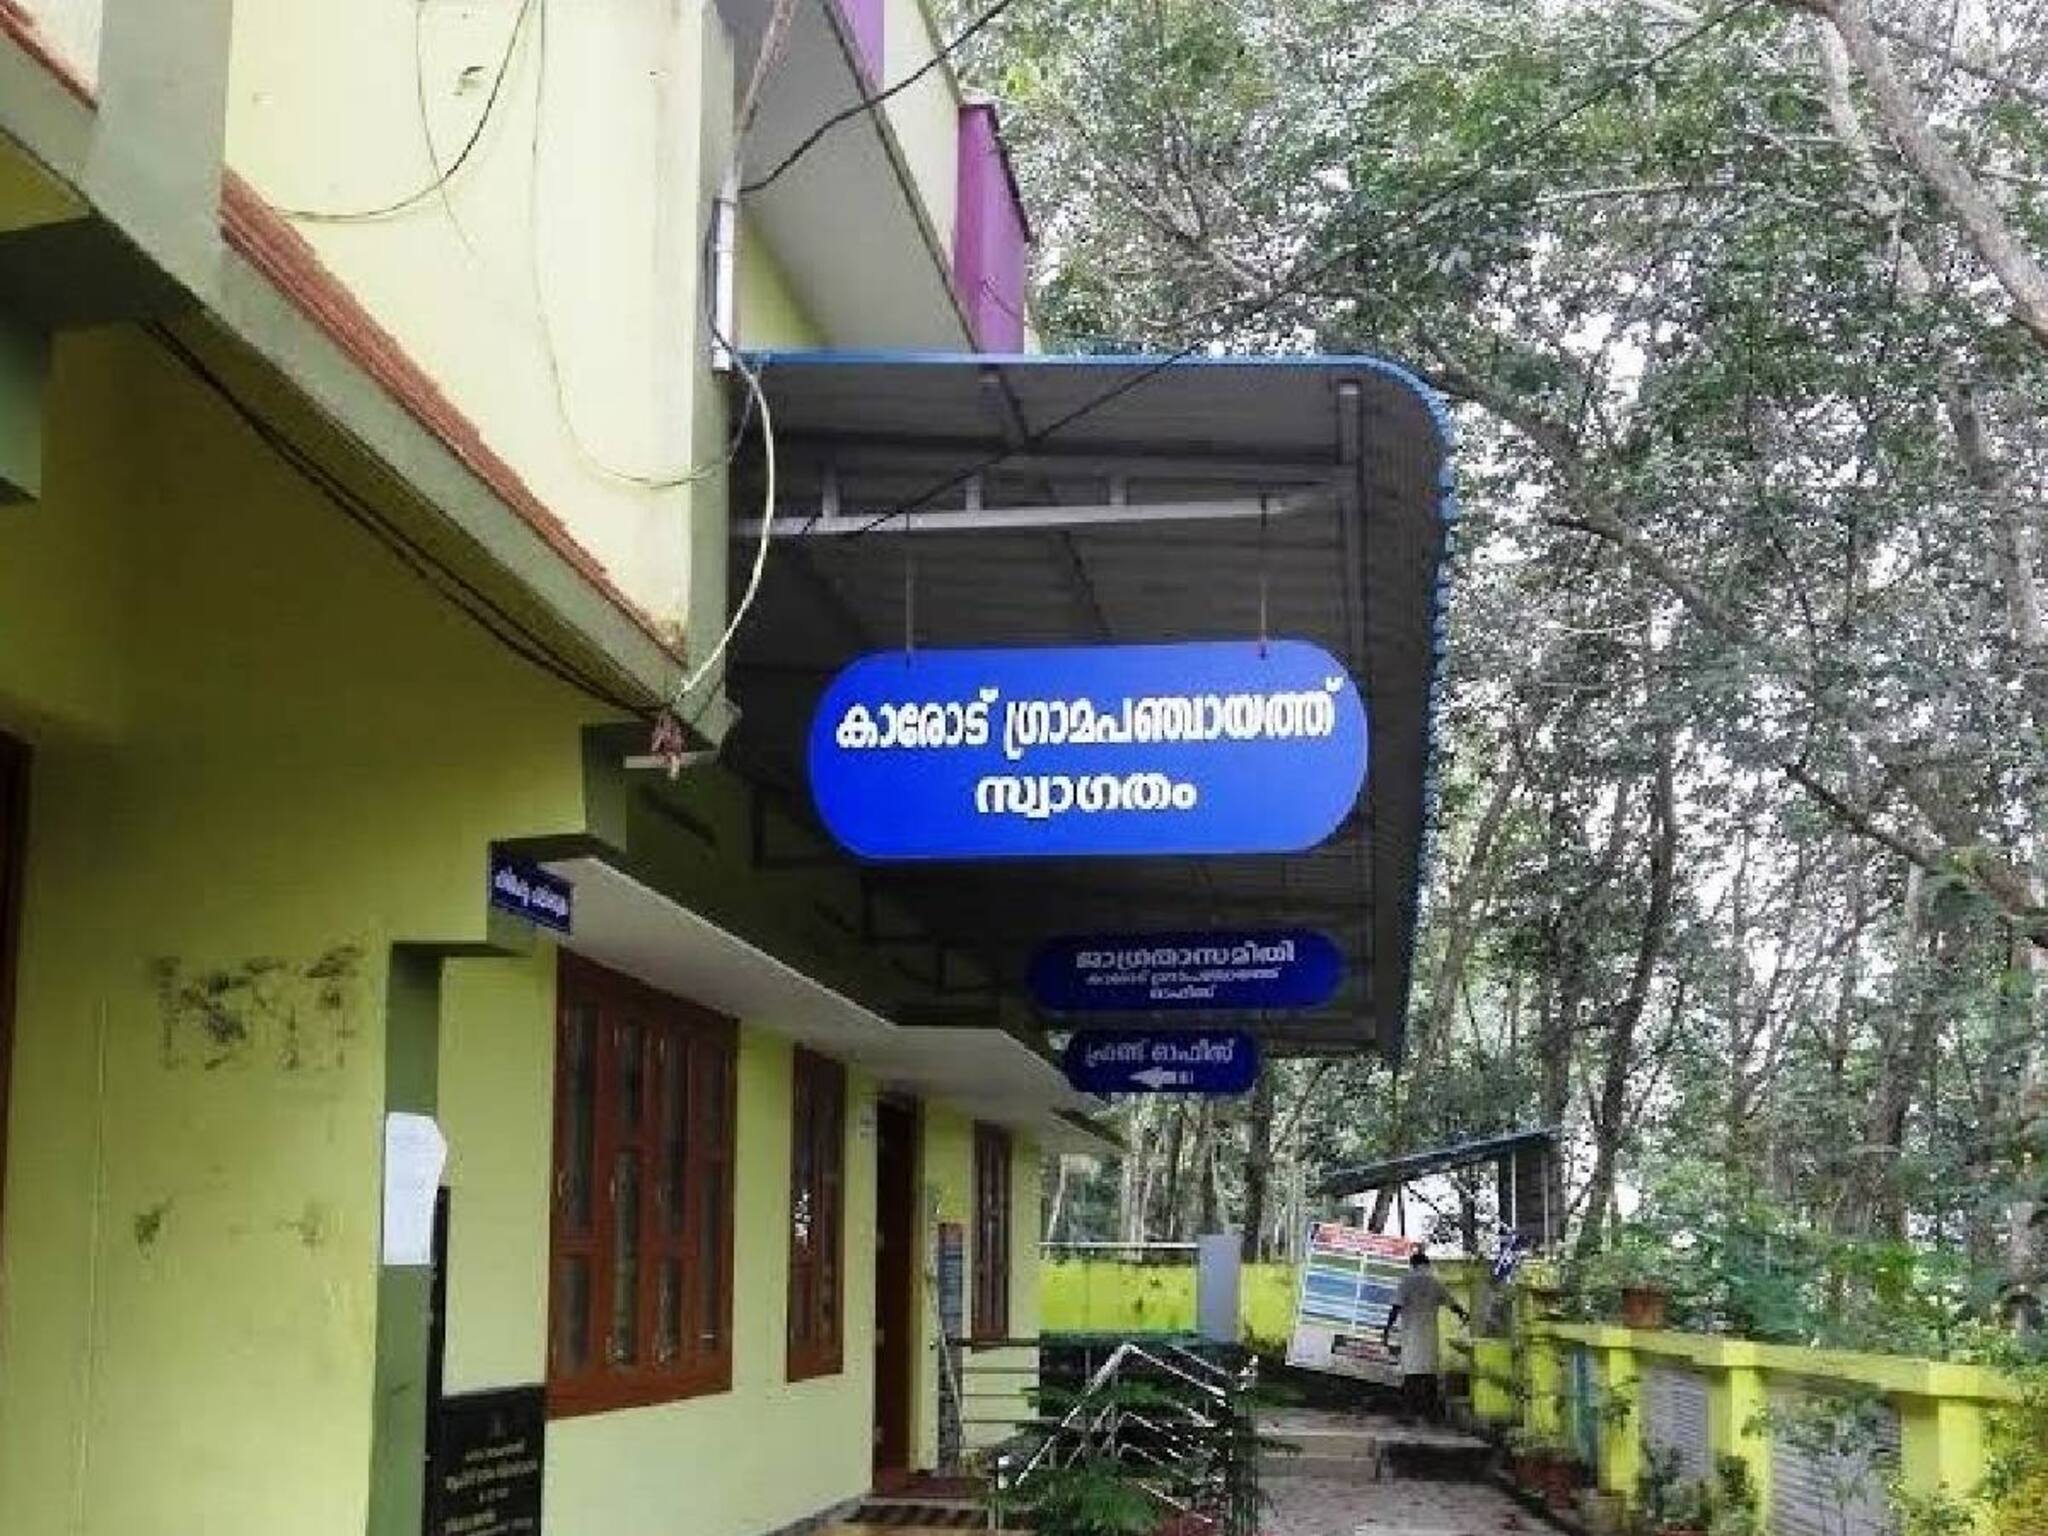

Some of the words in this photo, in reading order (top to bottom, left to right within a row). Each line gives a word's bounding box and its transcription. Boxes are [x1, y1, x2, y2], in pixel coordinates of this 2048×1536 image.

[836, 688, 999, 748] കാരോട്
[1003, 676, 1343, 760] ഗ്രാമപഞ്ചായത്ത്
[975, 774, 1197, 818] സ്വാഗതം
[1076, 940, 1295, 969] ജാഗ്രതാസമിതി
